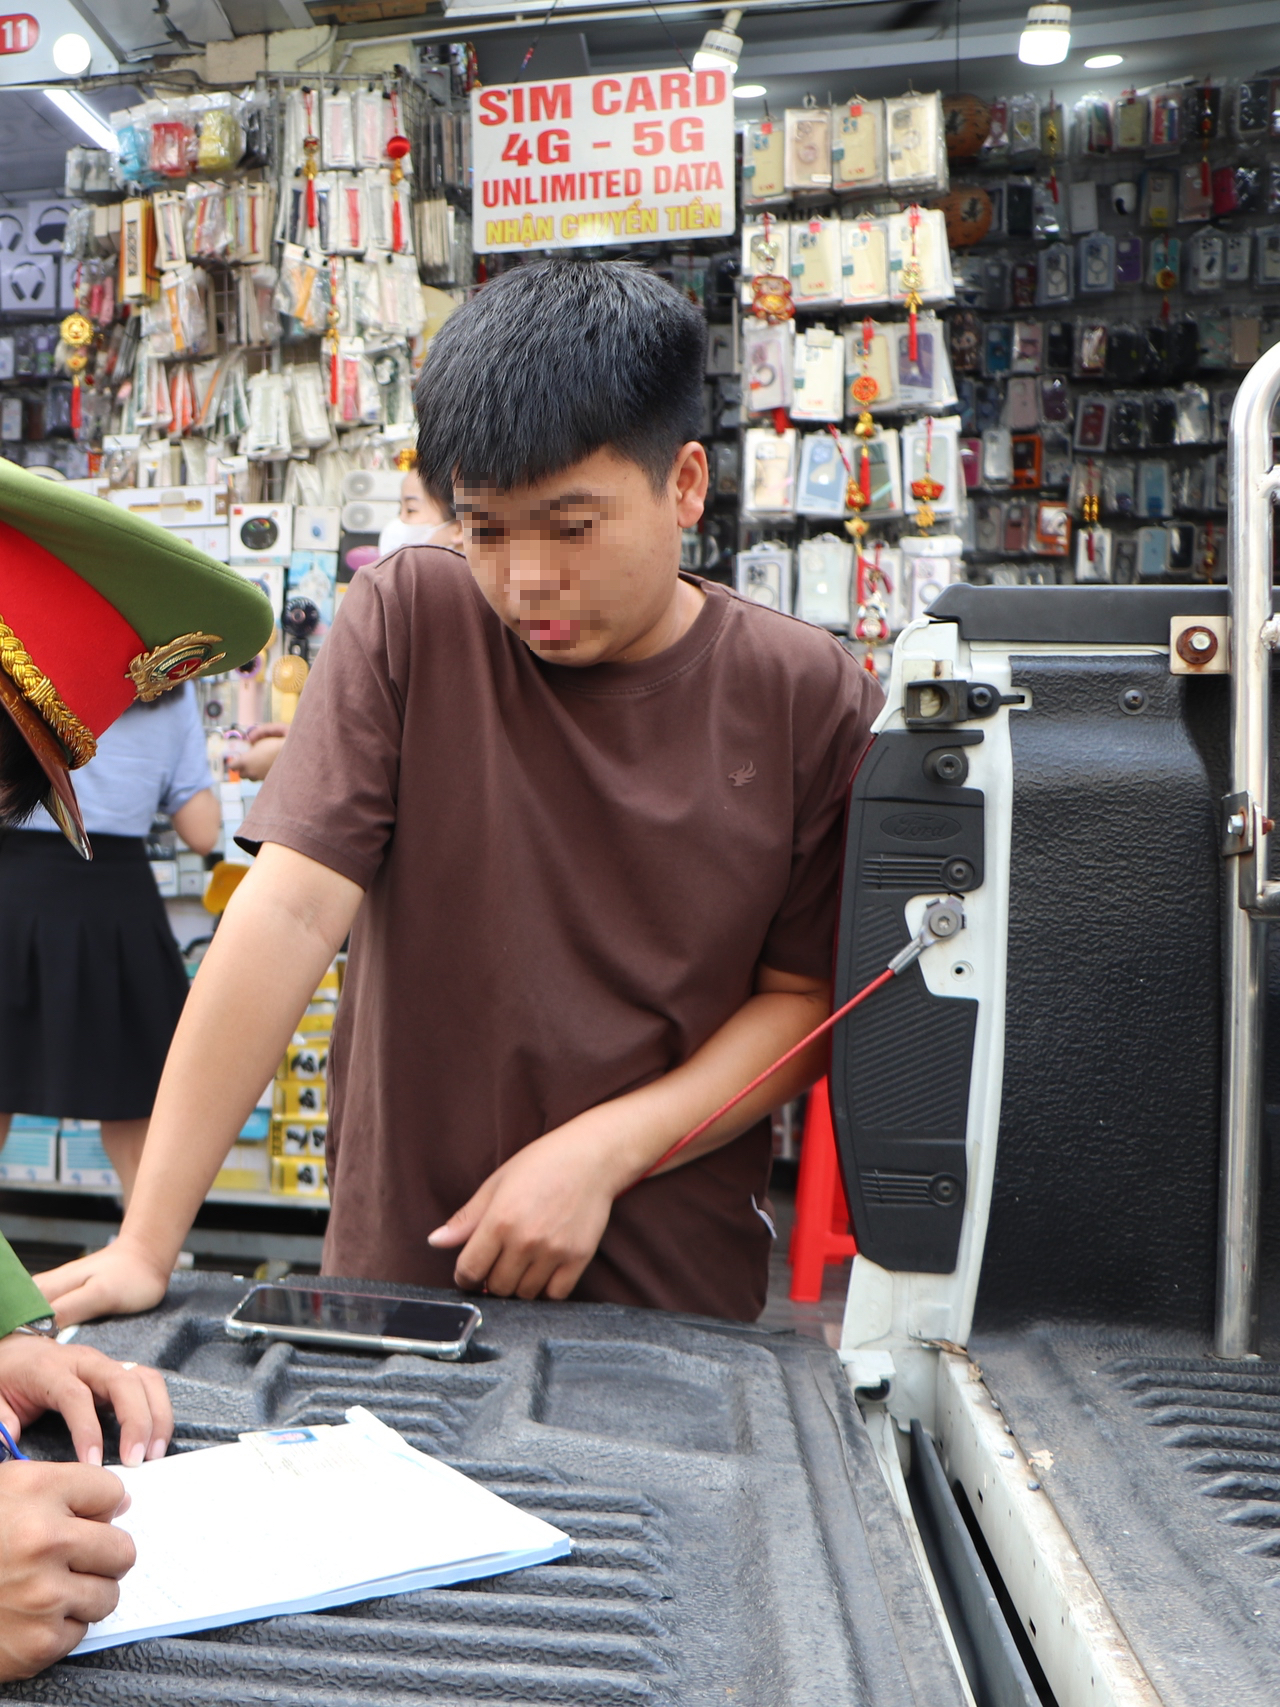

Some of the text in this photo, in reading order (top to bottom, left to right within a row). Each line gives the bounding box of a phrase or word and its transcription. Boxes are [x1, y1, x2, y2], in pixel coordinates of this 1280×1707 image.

[478, 69, 727, 126] SIM CARD
[501, 116, 704, 166] 4G - 5G
[482, 161, 725, 208] UNLIMITED DATA
[485, 196, 722, 248] NHẬN CHUYỂN TIỀN
[894, 815, 949, 837] Ford
